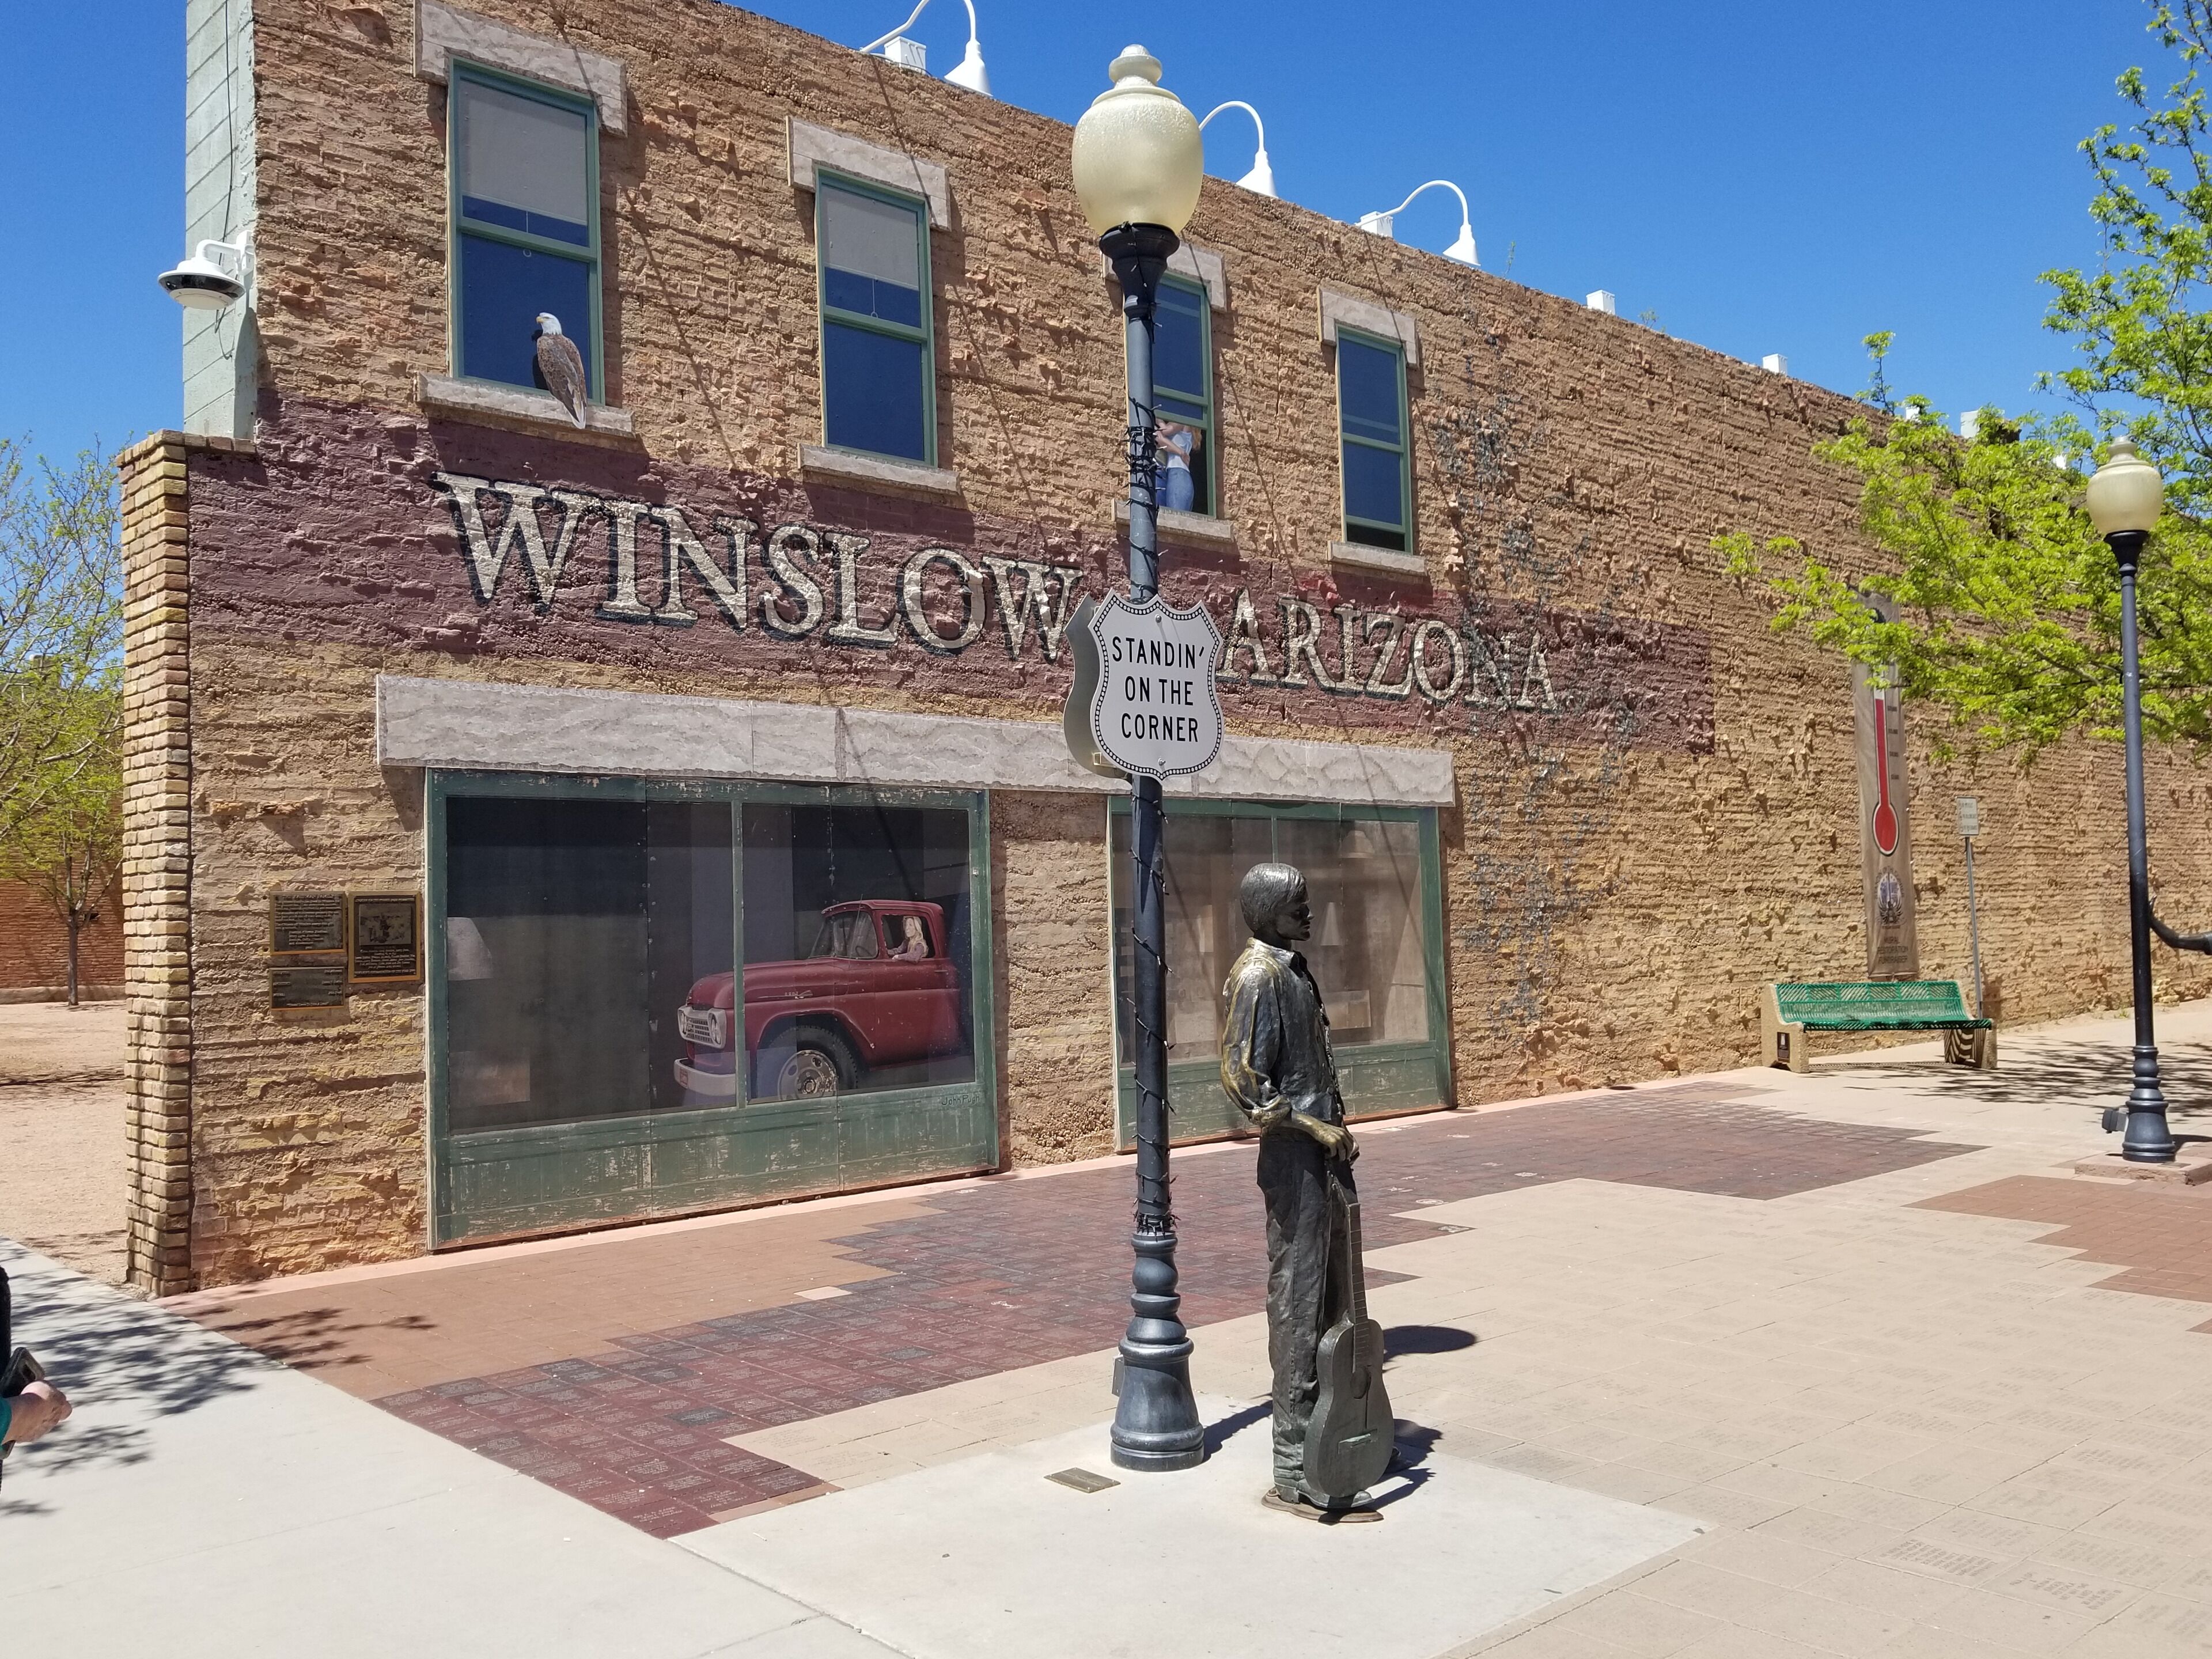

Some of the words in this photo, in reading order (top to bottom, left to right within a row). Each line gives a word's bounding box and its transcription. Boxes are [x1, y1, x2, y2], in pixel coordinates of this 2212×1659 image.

[429, 471, 1083, 662] WINSLOW
[1215, 586, 1558, 711] ARIZONA
[1112, 636, 1205, 669] STANDIN'
[1125, 676, 1150, 702] ON
[1158, 679, 1194, 706] THE
[1121, 713, 1199, 743] CORNER
[941, 1096, 961, 1106] John
[962, 1094, 980, 1104] Pugh
